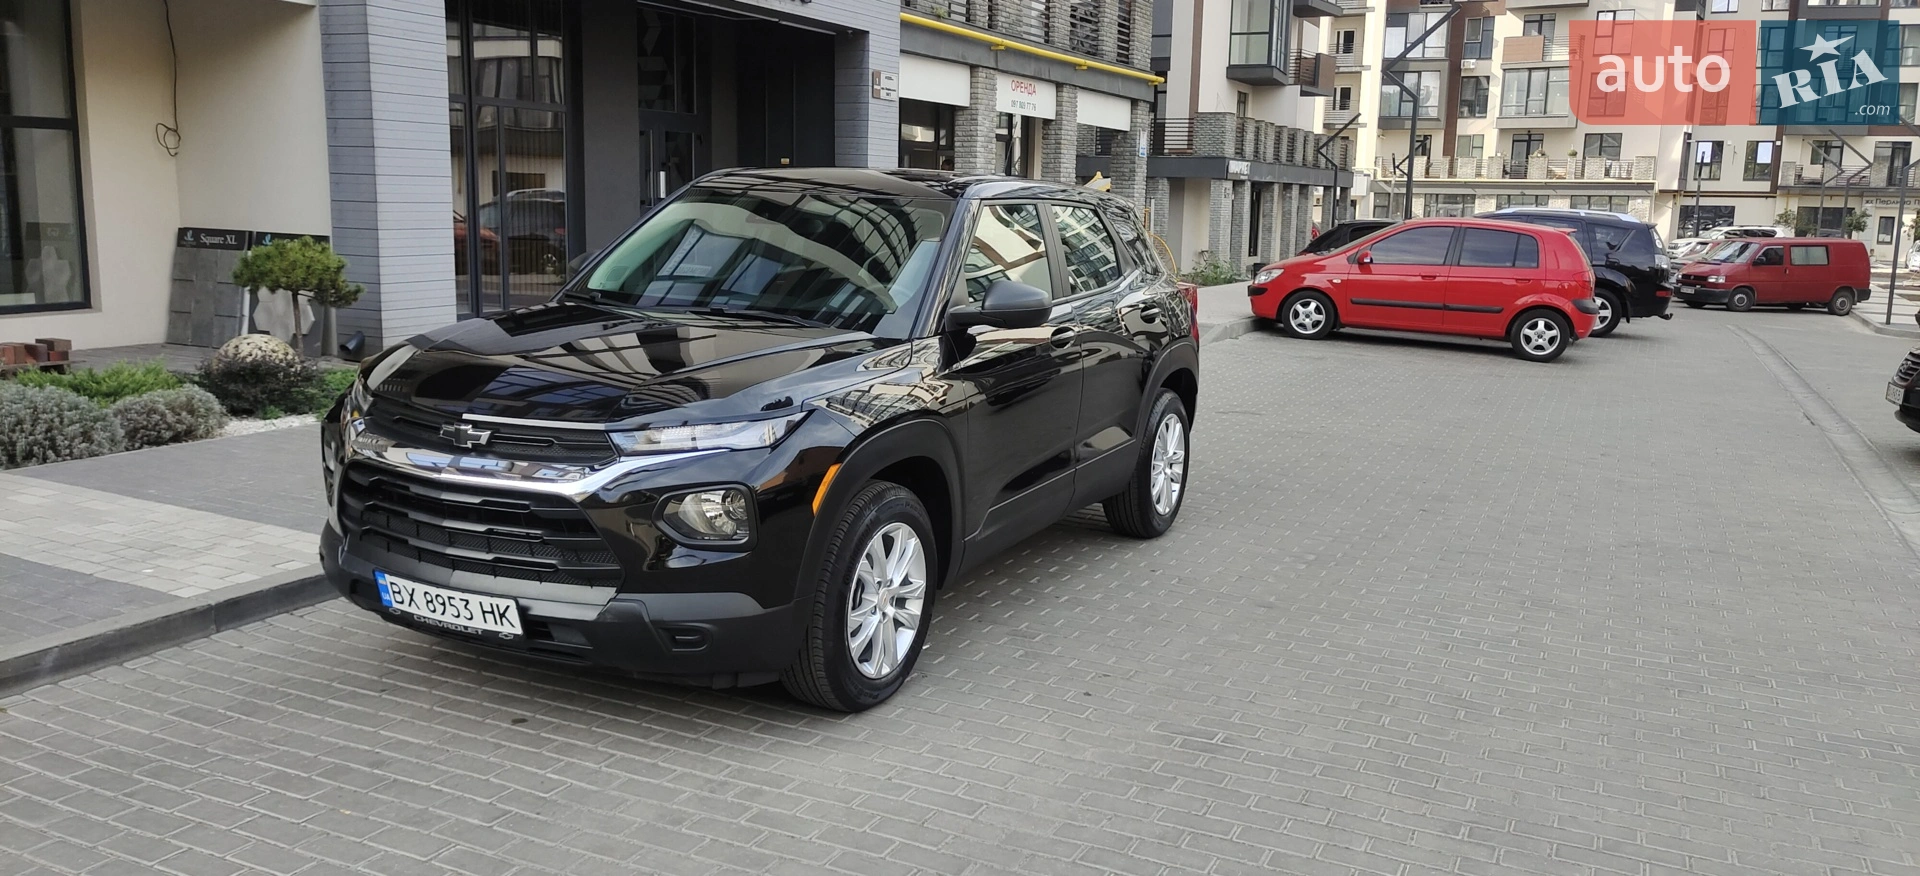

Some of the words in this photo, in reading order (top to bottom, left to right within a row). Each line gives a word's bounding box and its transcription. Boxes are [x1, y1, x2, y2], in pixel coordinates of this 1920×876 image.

[1011, 79, 1037, 97] ОРЕНДА
[200, 233, 225, 246] Square
[225, 234, 238, 245] XL
[382, 592, 391, 601] UA
[389, 581, 421, 611] BX
[423, 591, 474, 621] 8953
[479, 601, 516, 628] HK
[413, 614, 484, 636] CHEVROLET
